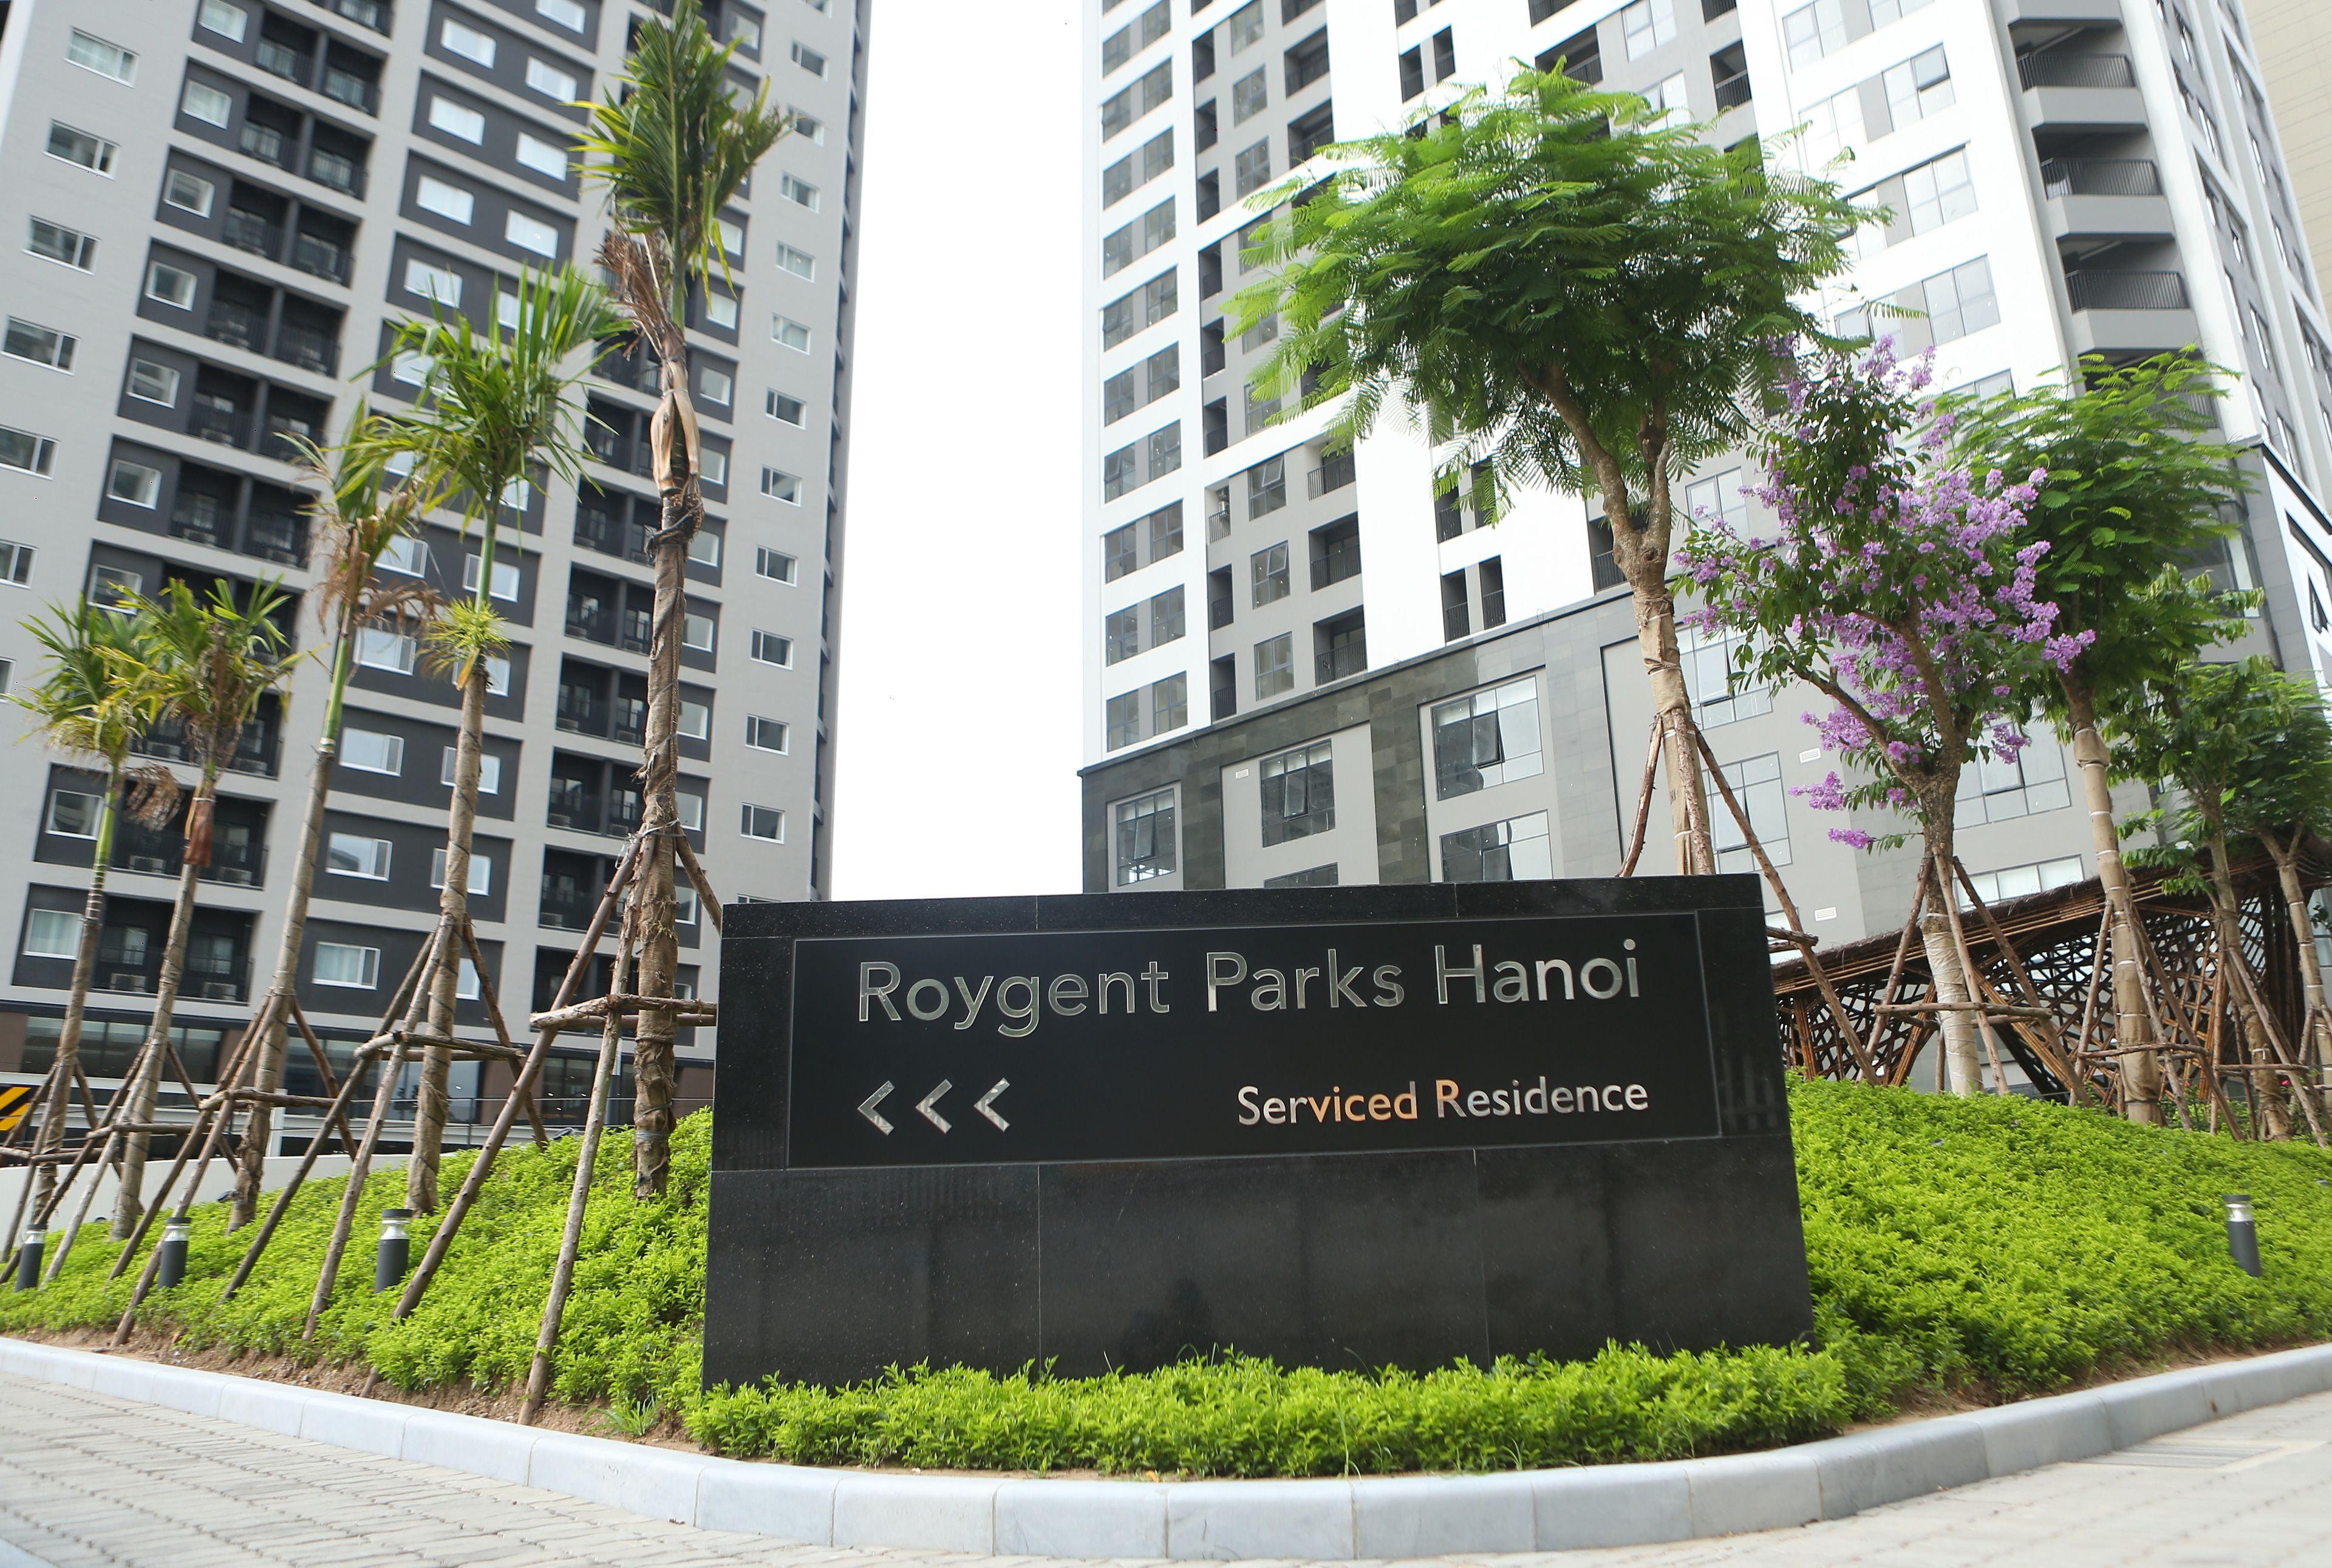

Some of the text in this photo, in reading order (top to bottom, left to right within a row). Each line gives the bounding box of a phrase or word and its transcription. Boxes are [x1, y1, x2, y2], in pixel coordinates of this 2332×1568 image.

[858, 938, 1640, 1037] Roygent Parks Hanoi
[1237, 1075, 1649, 1125] Serviced Residence
